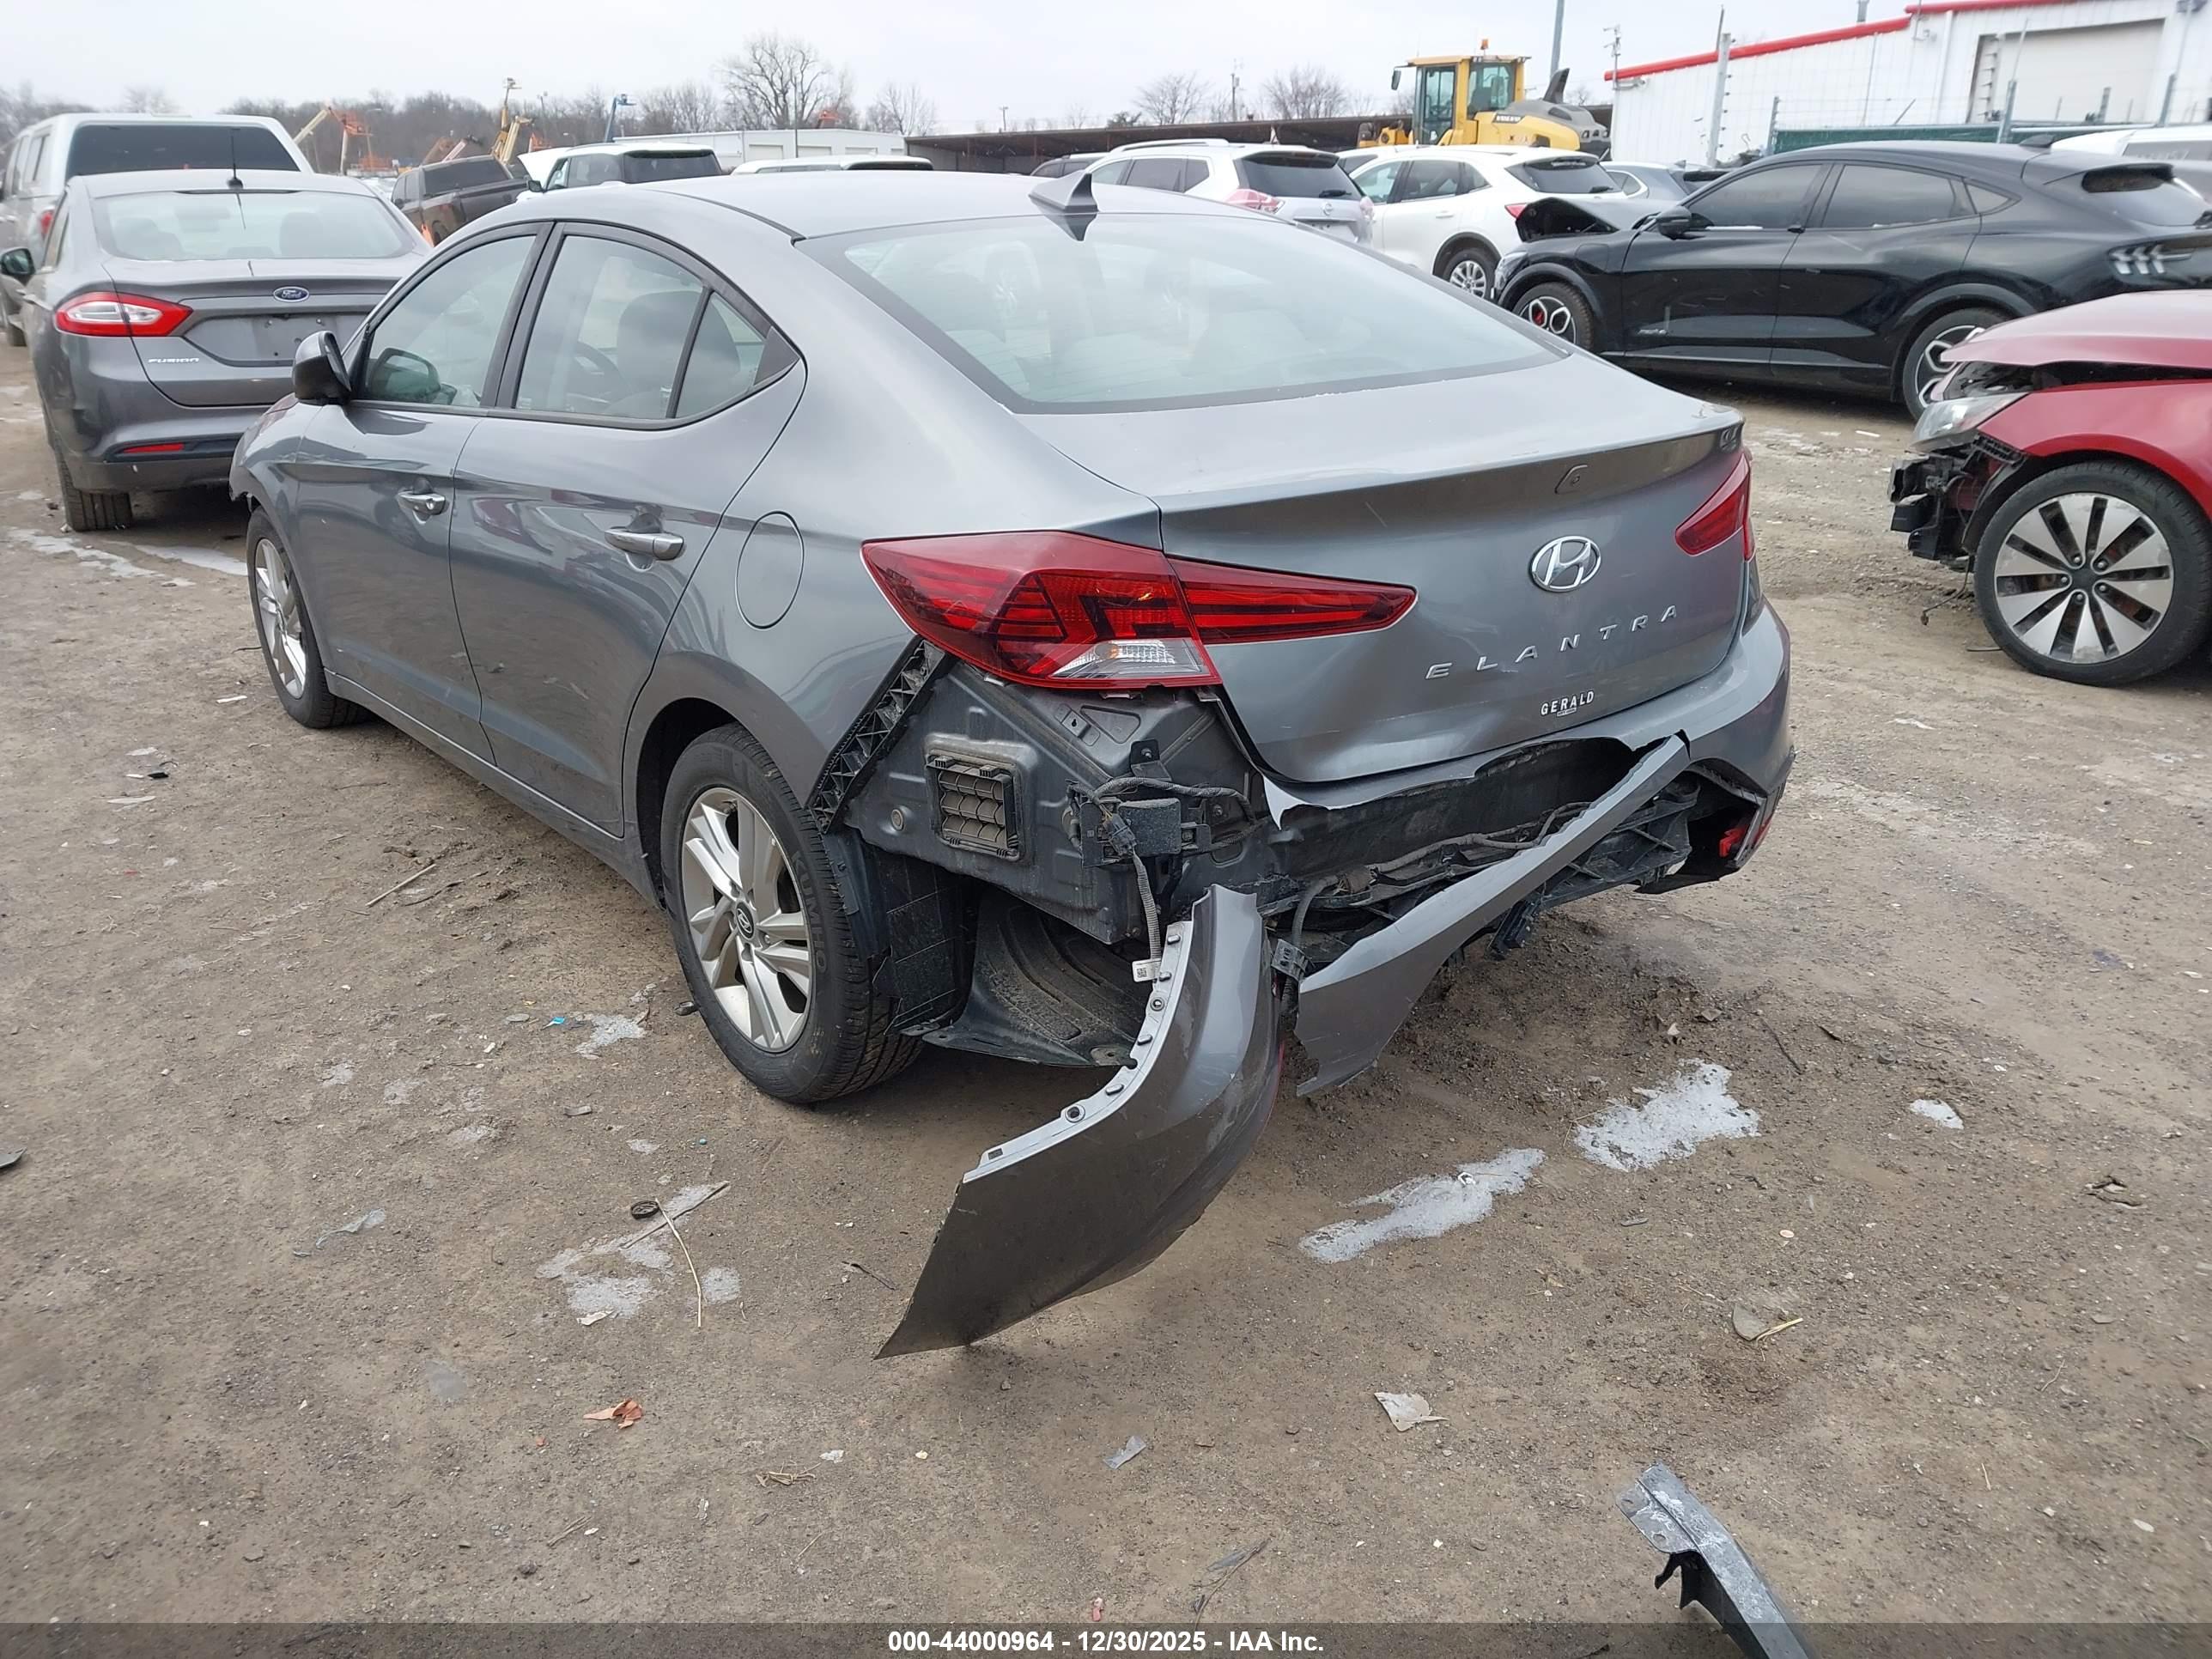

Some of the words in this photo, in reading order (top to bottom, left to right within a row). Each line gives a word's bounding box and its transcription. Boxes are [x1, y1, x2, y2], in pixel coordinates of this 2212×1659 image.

[281, 289, 304, 300] Ford
[1425, 605, 1677, 679] ELANTRA
[1540, 690, 1595, 715] GERALD
[792, 851, 827, 973] KUMHO
